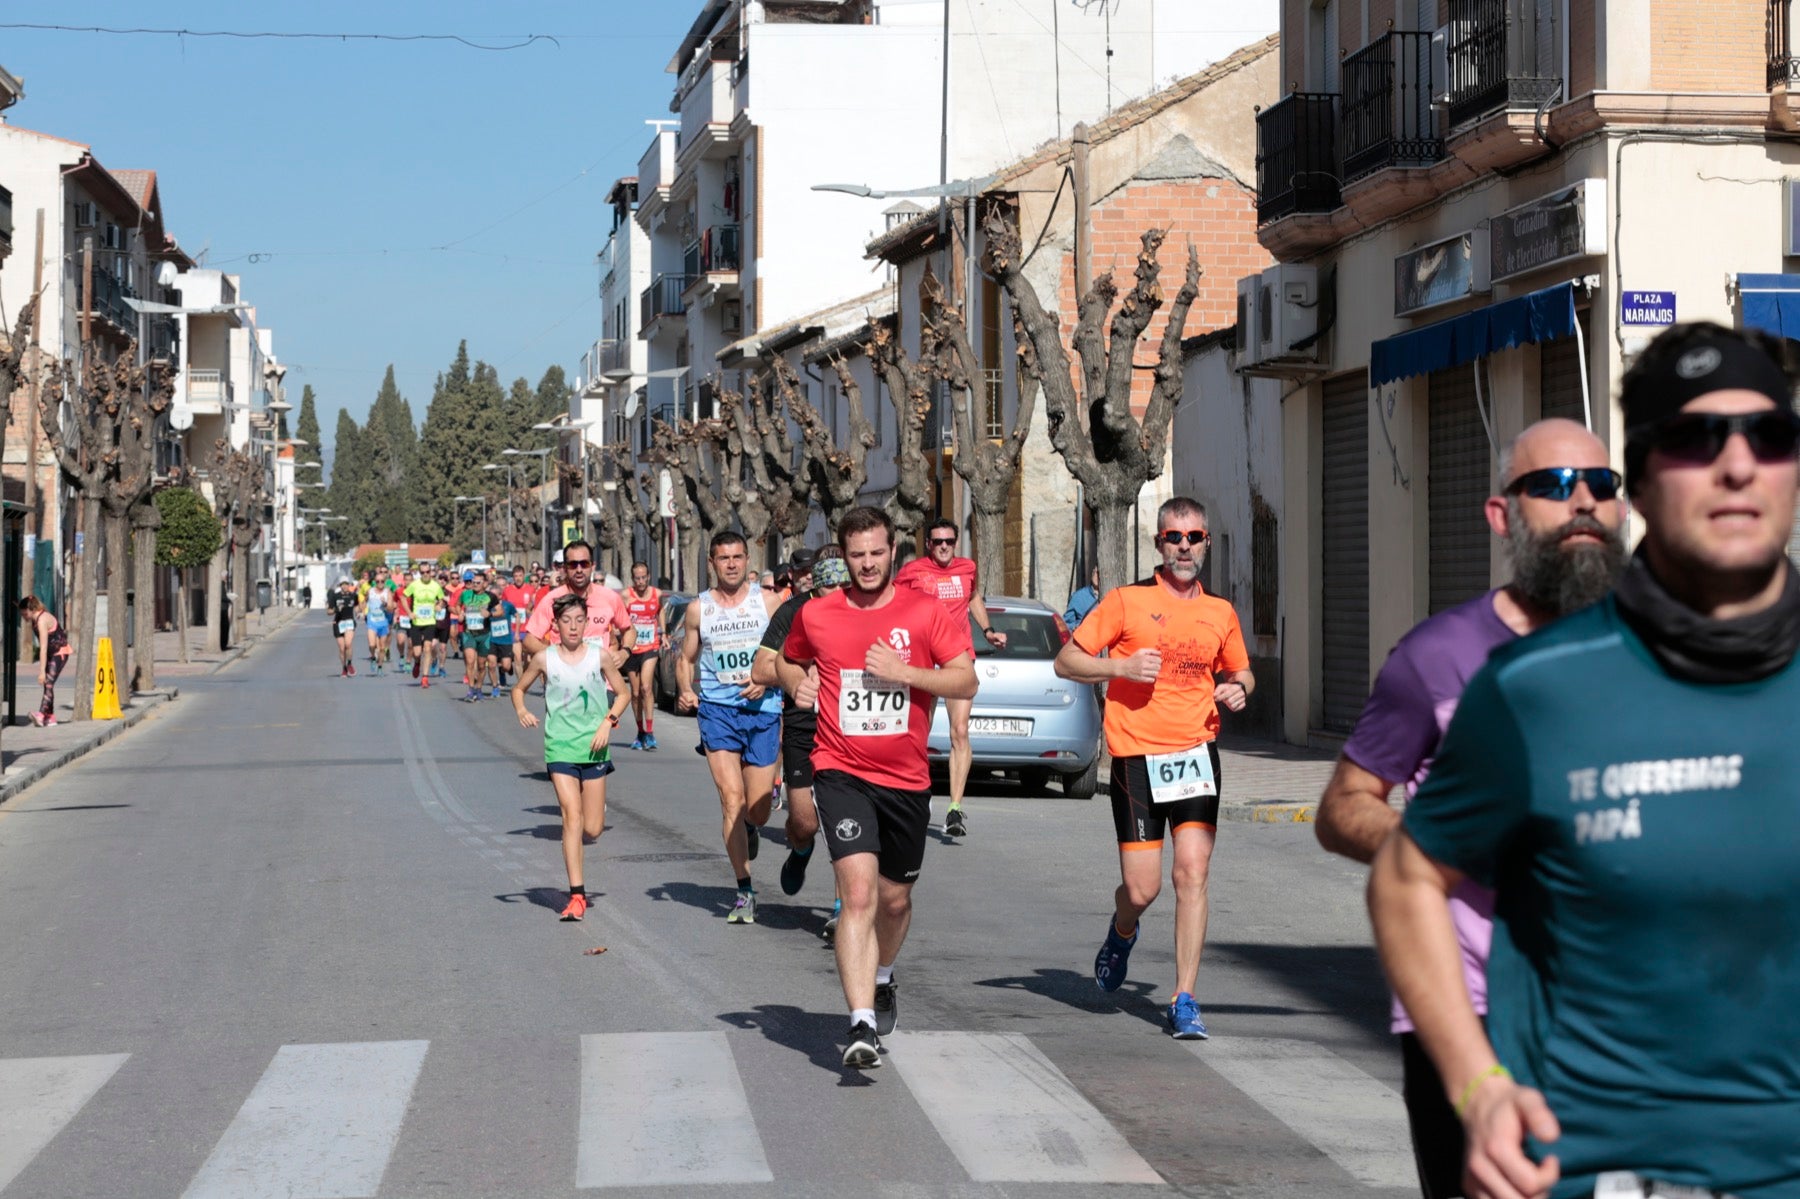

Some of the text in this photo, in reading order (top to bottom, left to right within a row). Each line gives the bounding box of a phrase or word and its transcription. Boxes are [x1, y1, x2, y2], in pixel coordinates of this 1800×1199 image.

[1513, 207, 1549, 237] Granadina
[1506, 252, 1515, 272] de
[1515, 236, 1558, 269] Electricidad
[1633, 294, 1662, 304] PLAZA
[1625, 308, 1673, 323] NARANJOS
[710, 620, 760, 634] MARACENA
[98, 667, 105, 694] 9
[846, 690, 906, 712] 3170
[1002, 719, 1025, 732] FNL
[1159, 759, 1201, 783] 671
[1567, 754, 1743, 802] TE QUEREMOS
[1574, 798, 1642, 845] PAPÁ
